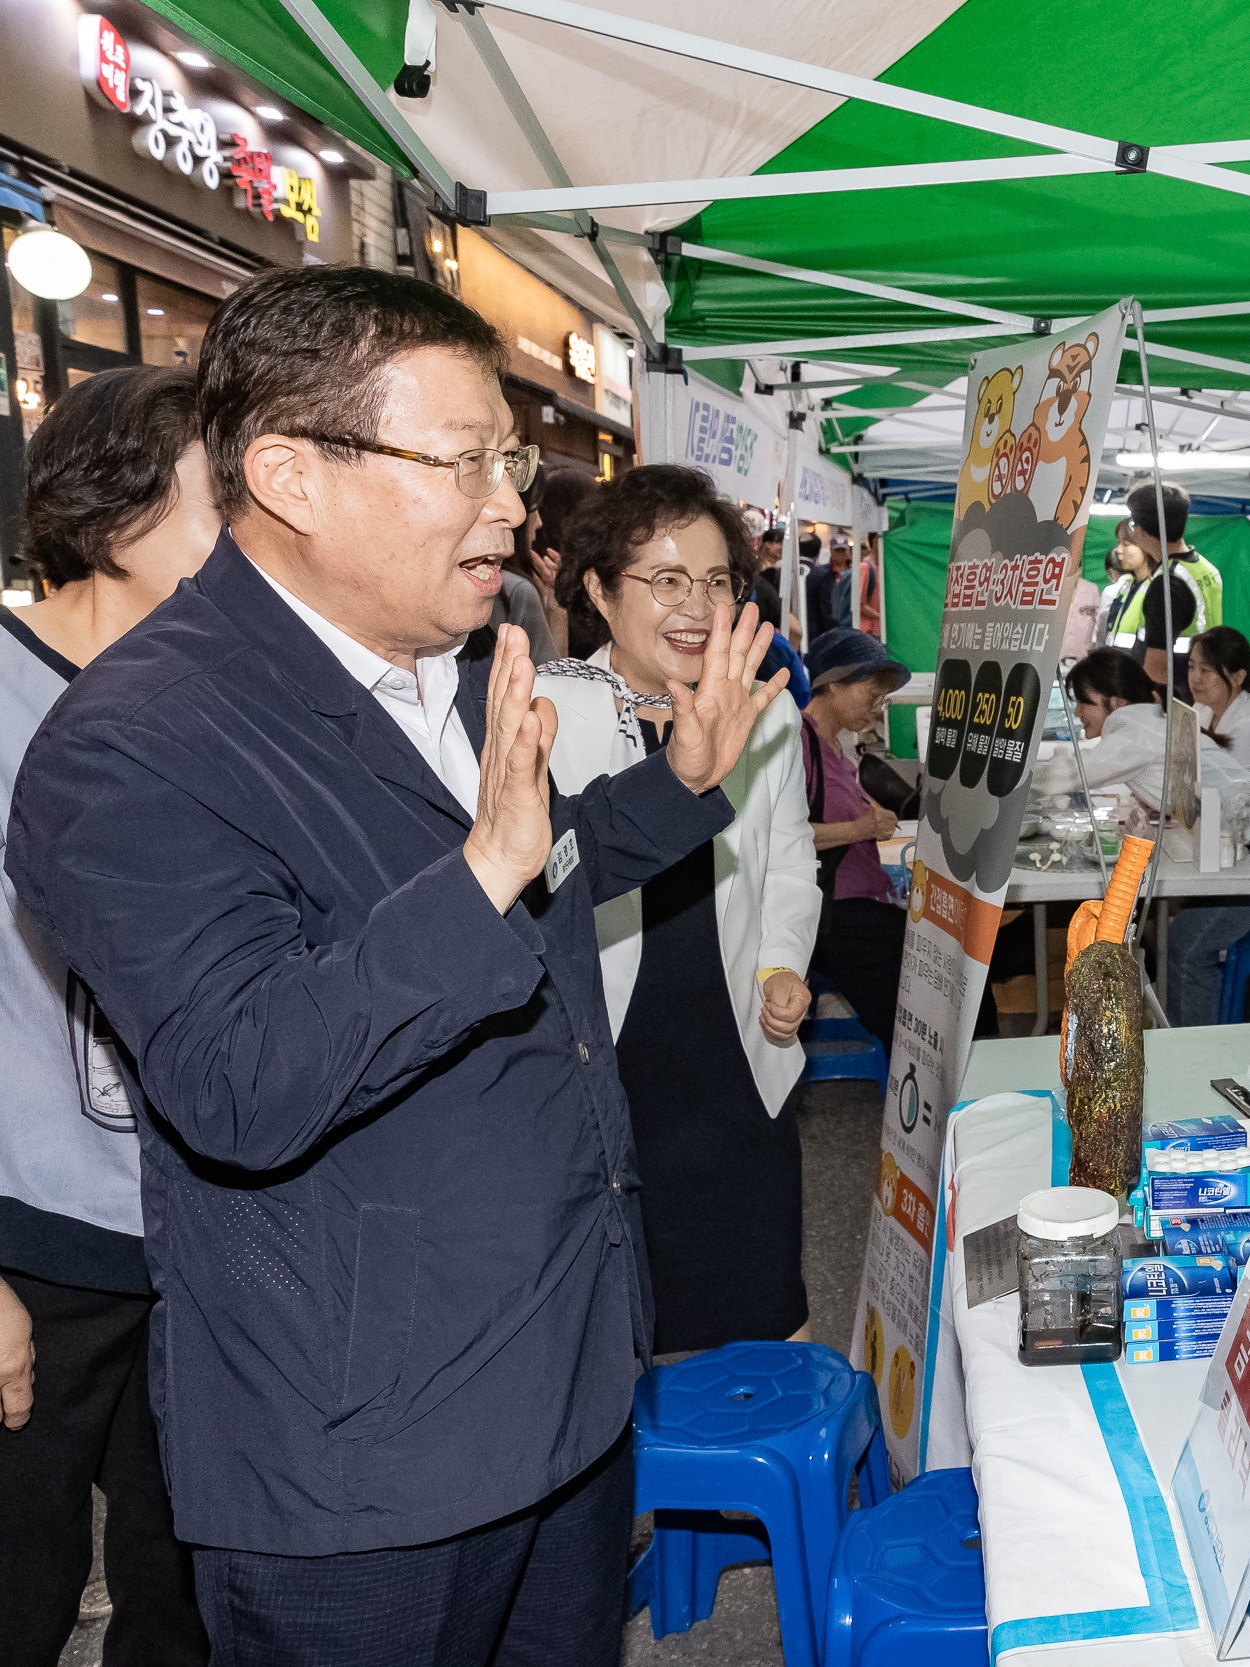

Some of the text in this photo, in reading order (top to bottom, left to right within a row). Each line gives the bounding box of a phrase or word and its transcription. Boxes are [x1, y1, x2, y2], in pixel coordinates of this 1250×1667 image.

[230, 133, 277, 222] 족발
[280, 166, 322, 242] 보쌈
[983, 622, 1050, 653] 들어있습니다
[937, 688, 1024, 730] 4,000 250 50
[946, 728, 958, 749] 물질
[966, 732, 991, 756] 유해 물질
[1004, 739, 1025, 763] 물질
[913, 1017, 928, 1041] 30분
[1198, 1183, 1232, 1197] 니코틴엘
[900, 1187, 917, 1223] 3차
[1144, 1264, 1168, 1296] 니코틴엘
